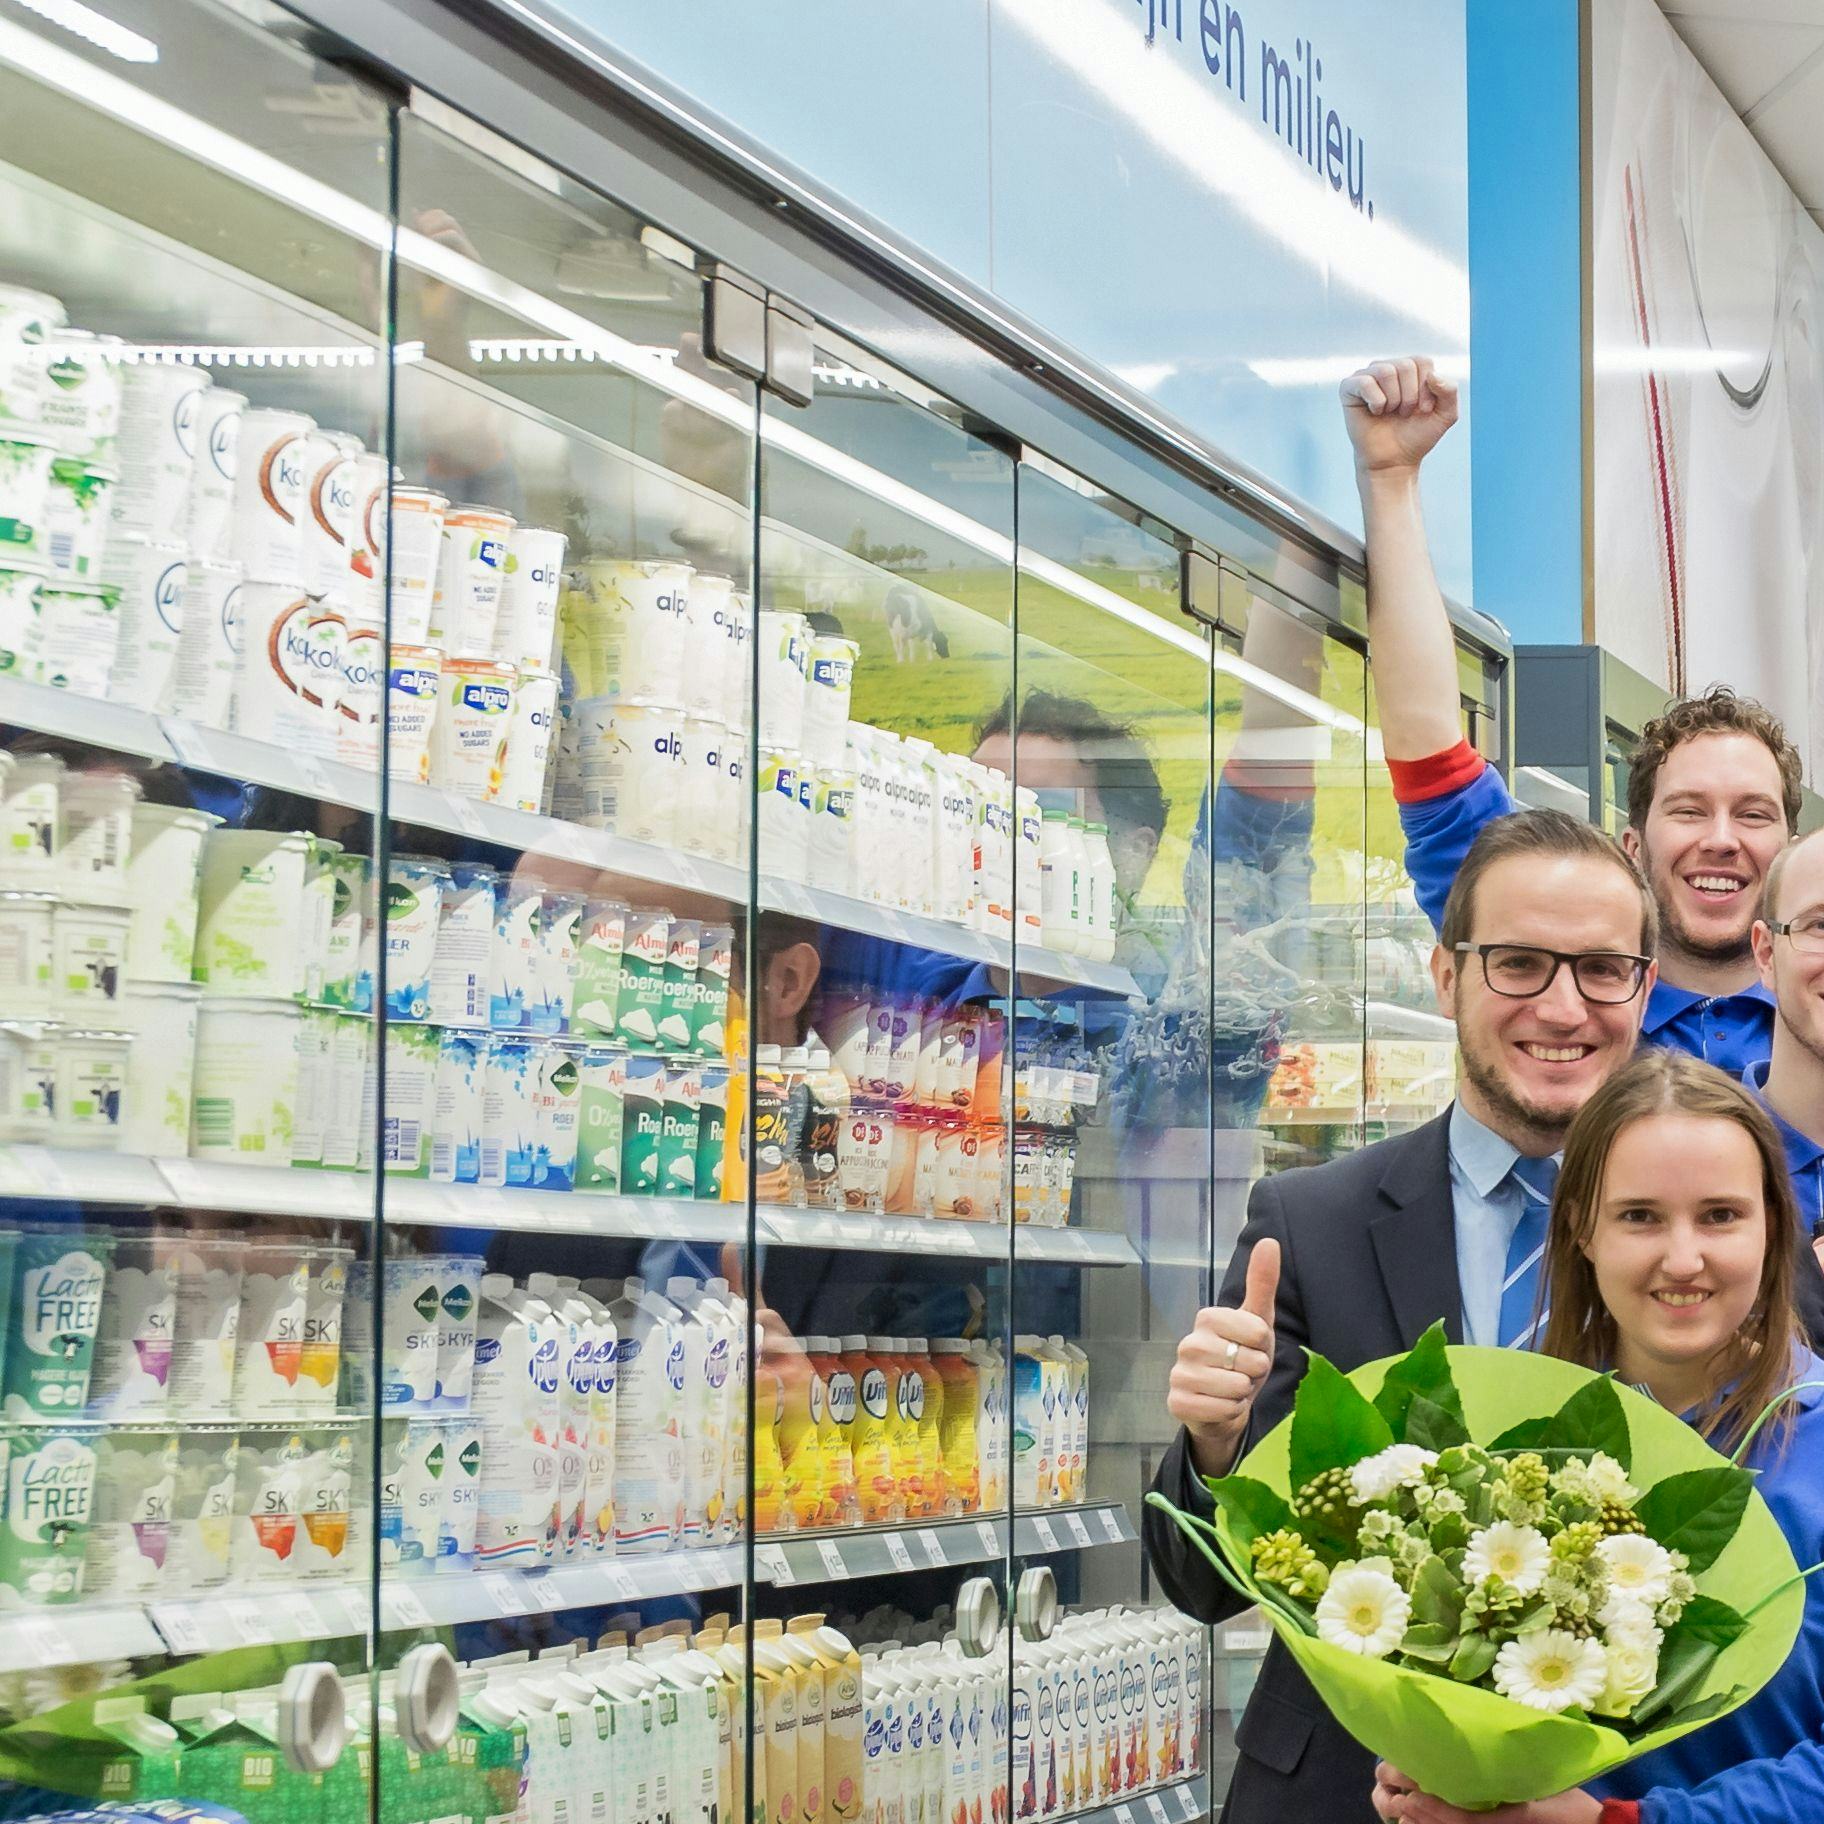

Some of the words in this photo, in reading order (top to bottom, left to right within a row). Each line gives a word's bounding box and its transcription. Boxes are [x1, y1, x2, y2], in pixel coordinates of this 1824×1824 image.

[1201, 0, 1246, 102] en
[1262, 38, 1375, 222] milieu.
[467, 687, 509, 707] alpro
[36, 1300, 96, 1332] FREE
[24, 1487, 88, 1519] FREE
